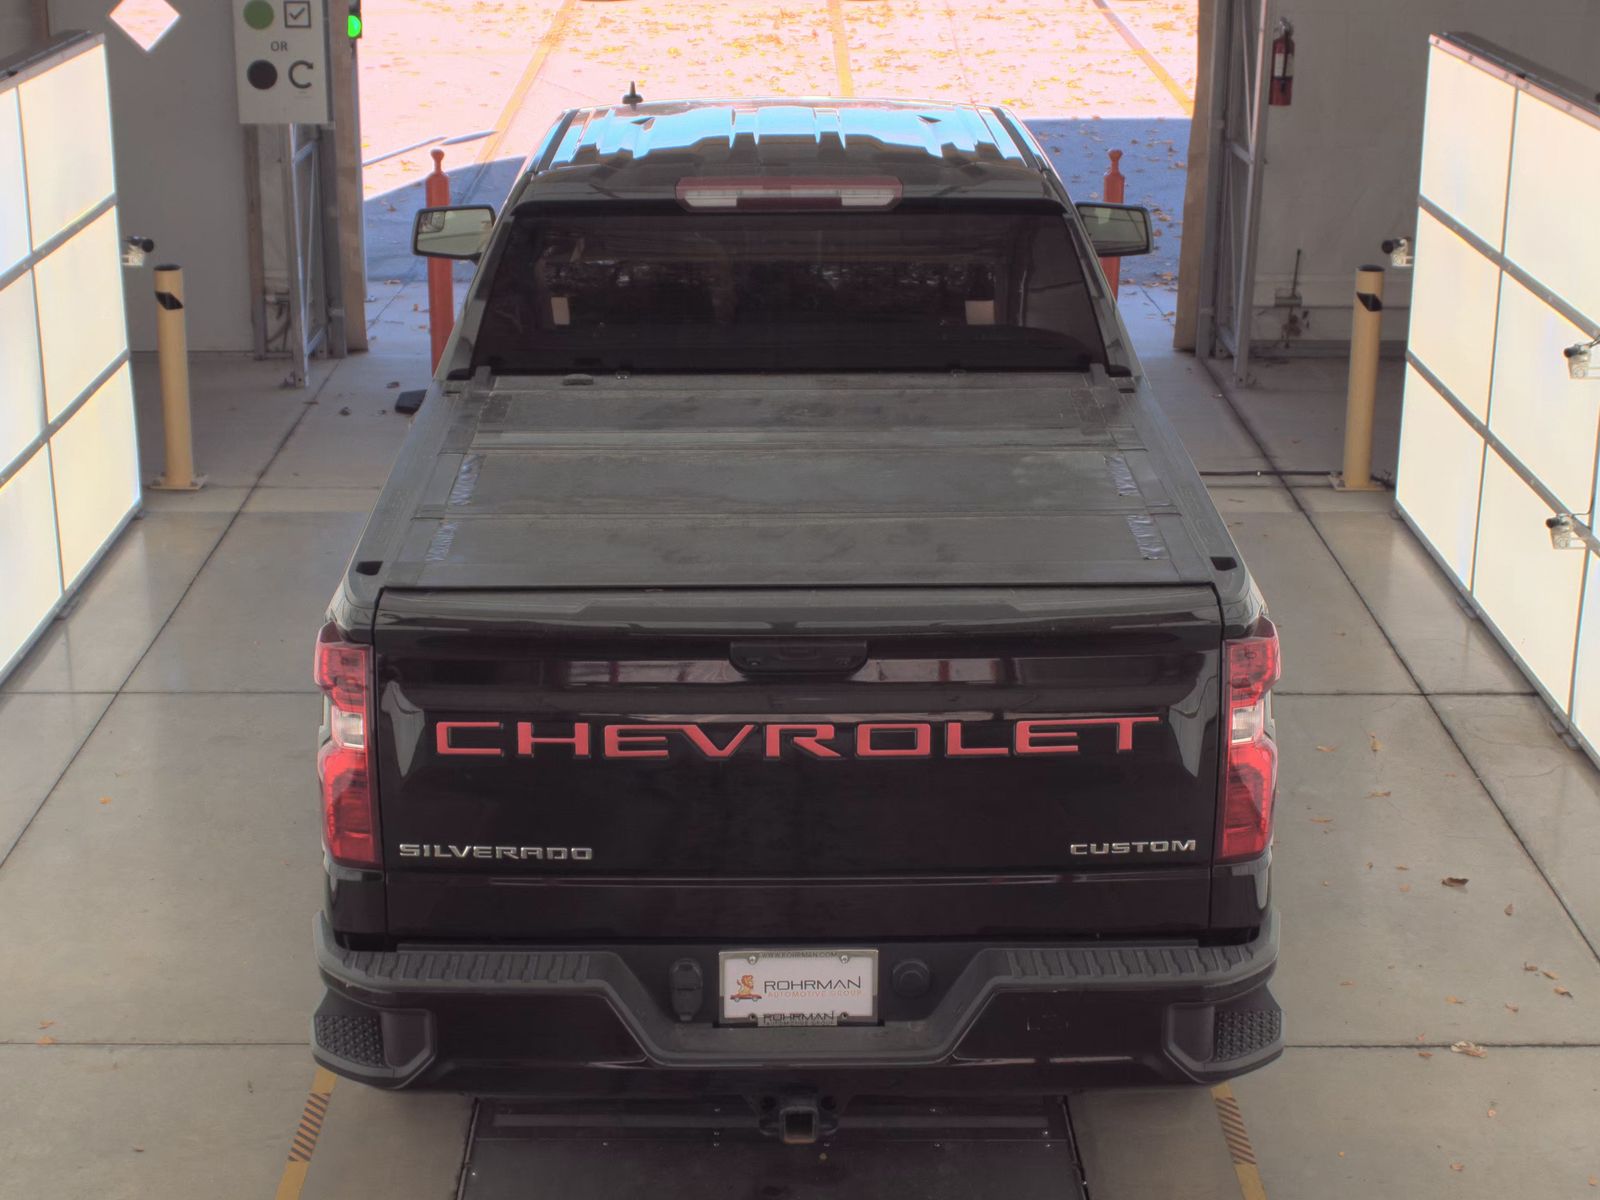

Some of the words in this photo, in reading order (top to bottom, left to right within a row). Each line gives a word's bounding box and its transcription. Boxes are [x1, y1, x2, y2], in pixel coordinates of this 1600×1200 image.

[270, 41, 288, 52] OR
[435, 715, 1161, 759] CHEVROLET
[398, 843, 593, 861] SILVERADO
[1069, 838, 1197, 856] CUSTOM
[764, 975, 861, 994] ROHRMAN
[763, 1010, 834, 1024] ROHRMAN
